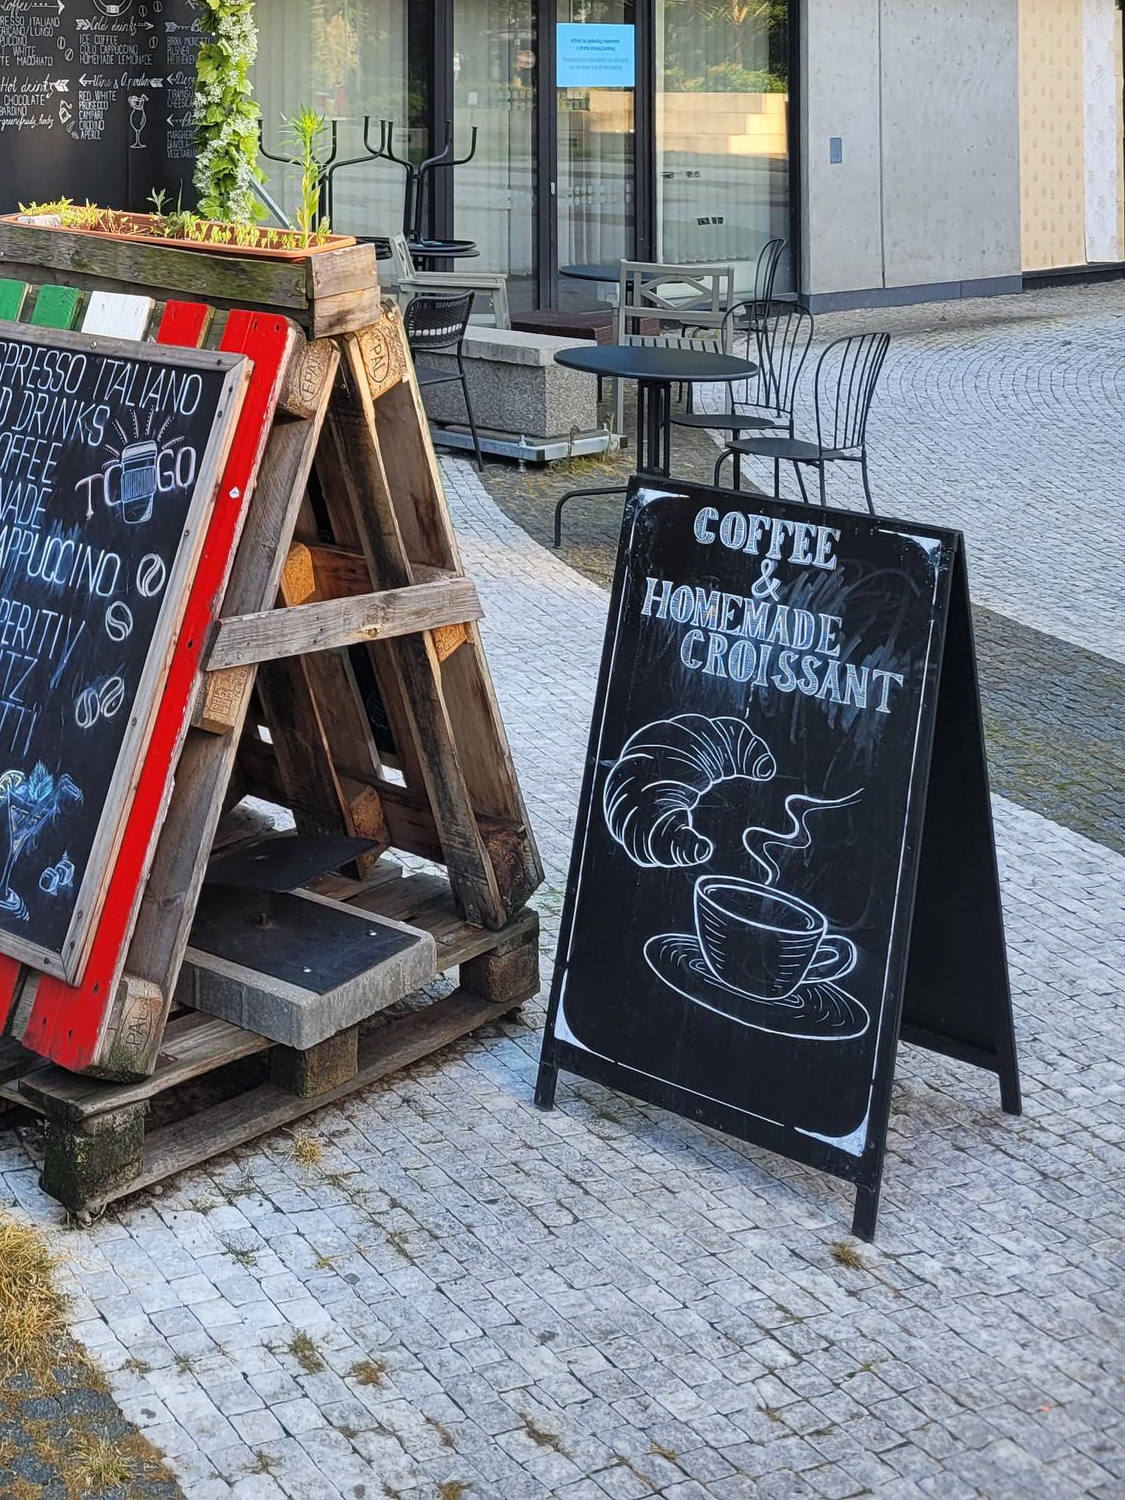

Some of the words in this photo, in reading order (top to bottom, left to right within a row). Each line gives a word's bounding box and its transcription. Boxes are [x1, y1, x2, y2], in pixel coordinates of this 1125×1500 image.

[29, 16, 60, 28] ITALIANO
[79, 33, 91, 45] ICE
[94, 34, 118, 45] COFFEE
[12, 46, 36, 56] WHITE
[0, 75, 17, 93] Hot
[94, 90, 117, 101] WHITE
[91, 358, 203, 416] ITALIANO
[11, 390, 110, 447] DRINKS
[156, 446, 197, 491] GO
[693, 506, 842, 571] COFFEE
[750, 558, 782, 602] &
[640, 577, 844, 658] HOMEMADE
[680, 629, 904, 714] CROISSANT
